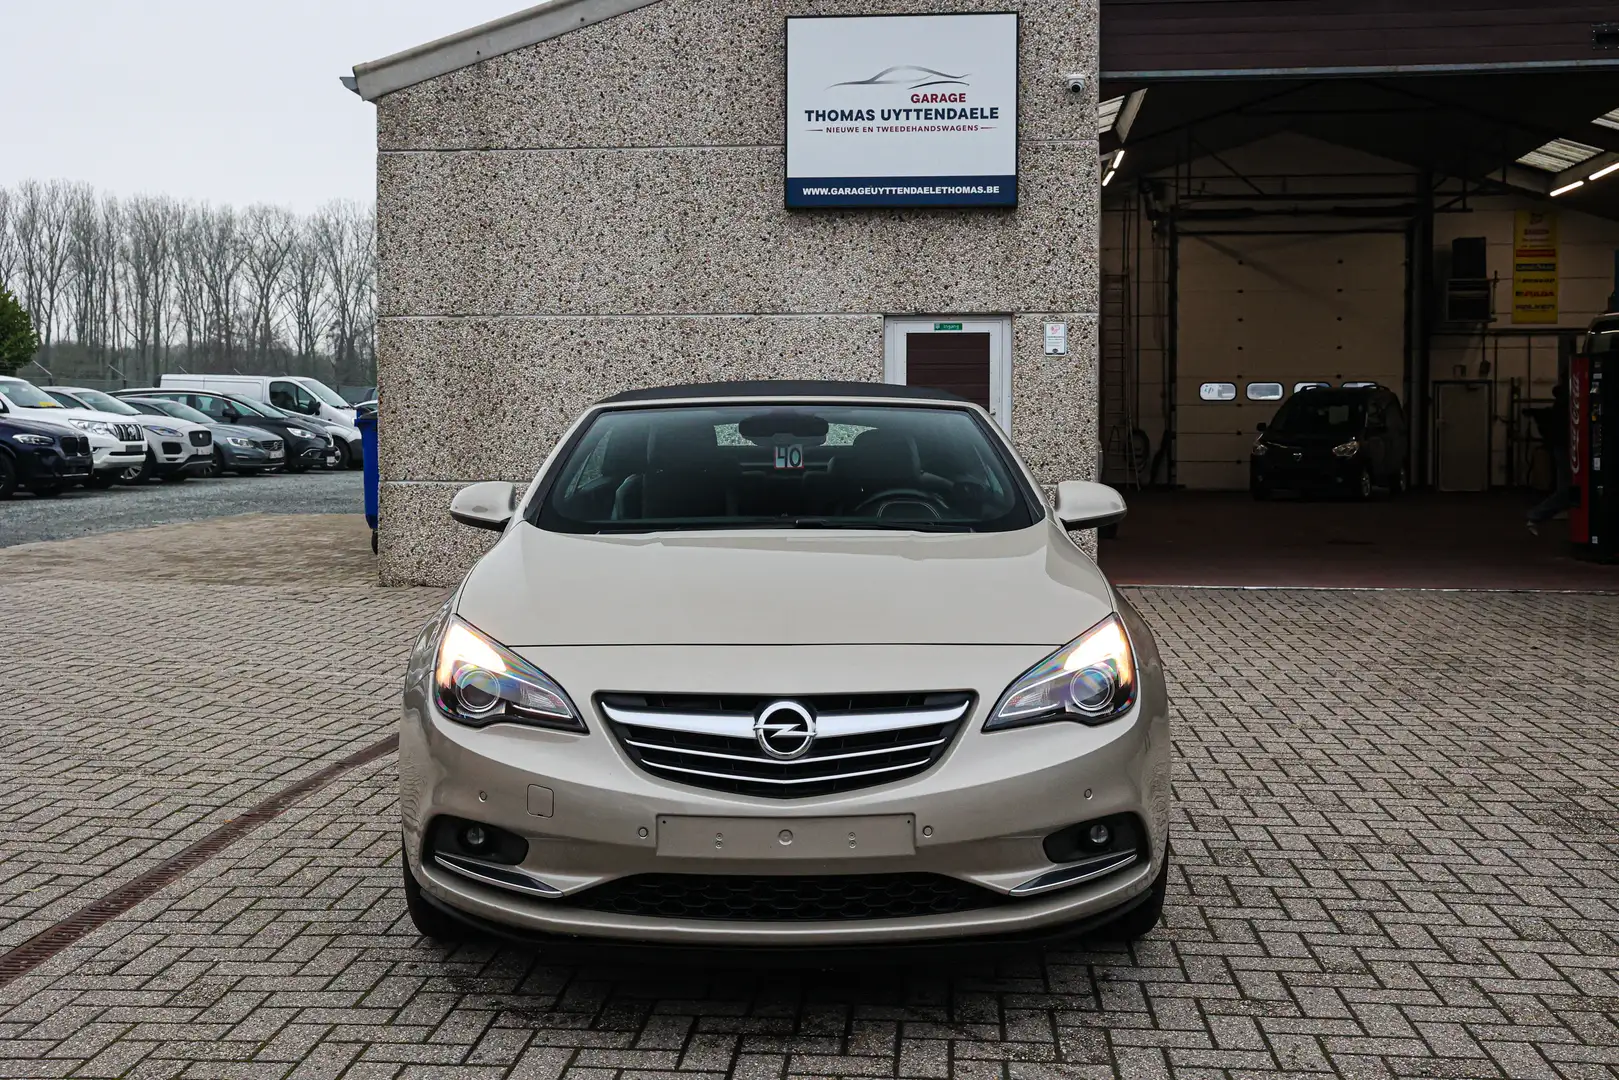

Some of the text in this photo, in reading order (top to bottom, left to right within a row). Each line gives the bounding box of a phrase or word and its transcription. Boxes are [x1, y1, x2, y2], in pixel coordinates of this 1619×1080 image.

[910, 93, 967, 104] GARAGE
[804, 107, 999, 122] THOMAS UYTTENDAELE
[876, 124, 979, 133] TWEEDEHANDSWAGENS
[802, 185, 1000, 196] WWW.GARAGEUYTTENDAELETHOMAS.BE
[777, 447, 801, 468] 40
